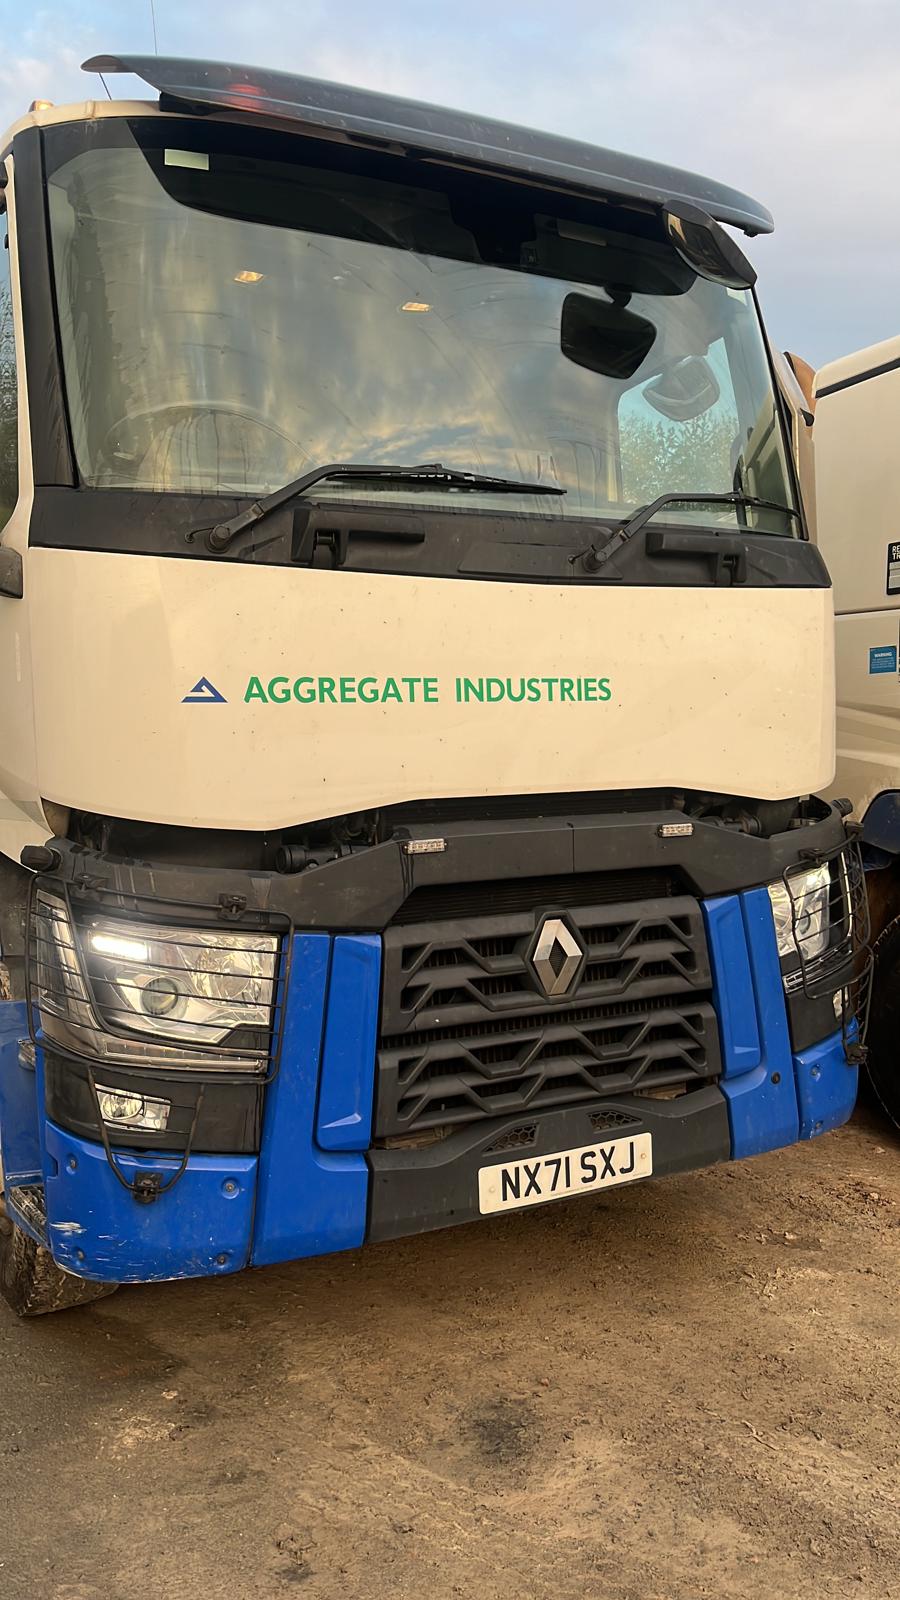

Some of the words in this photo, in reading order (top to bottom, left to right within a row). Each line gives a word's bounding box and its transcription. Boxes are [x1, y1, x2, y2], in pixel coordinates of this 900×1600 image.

[243, 676, 439, 703] AGGREGATE
[455, 677, 612, 702] INDUSTRIES
[501, 1155, 570, 1201] NX71
[580, 1141, 635, 1184] SXJ
